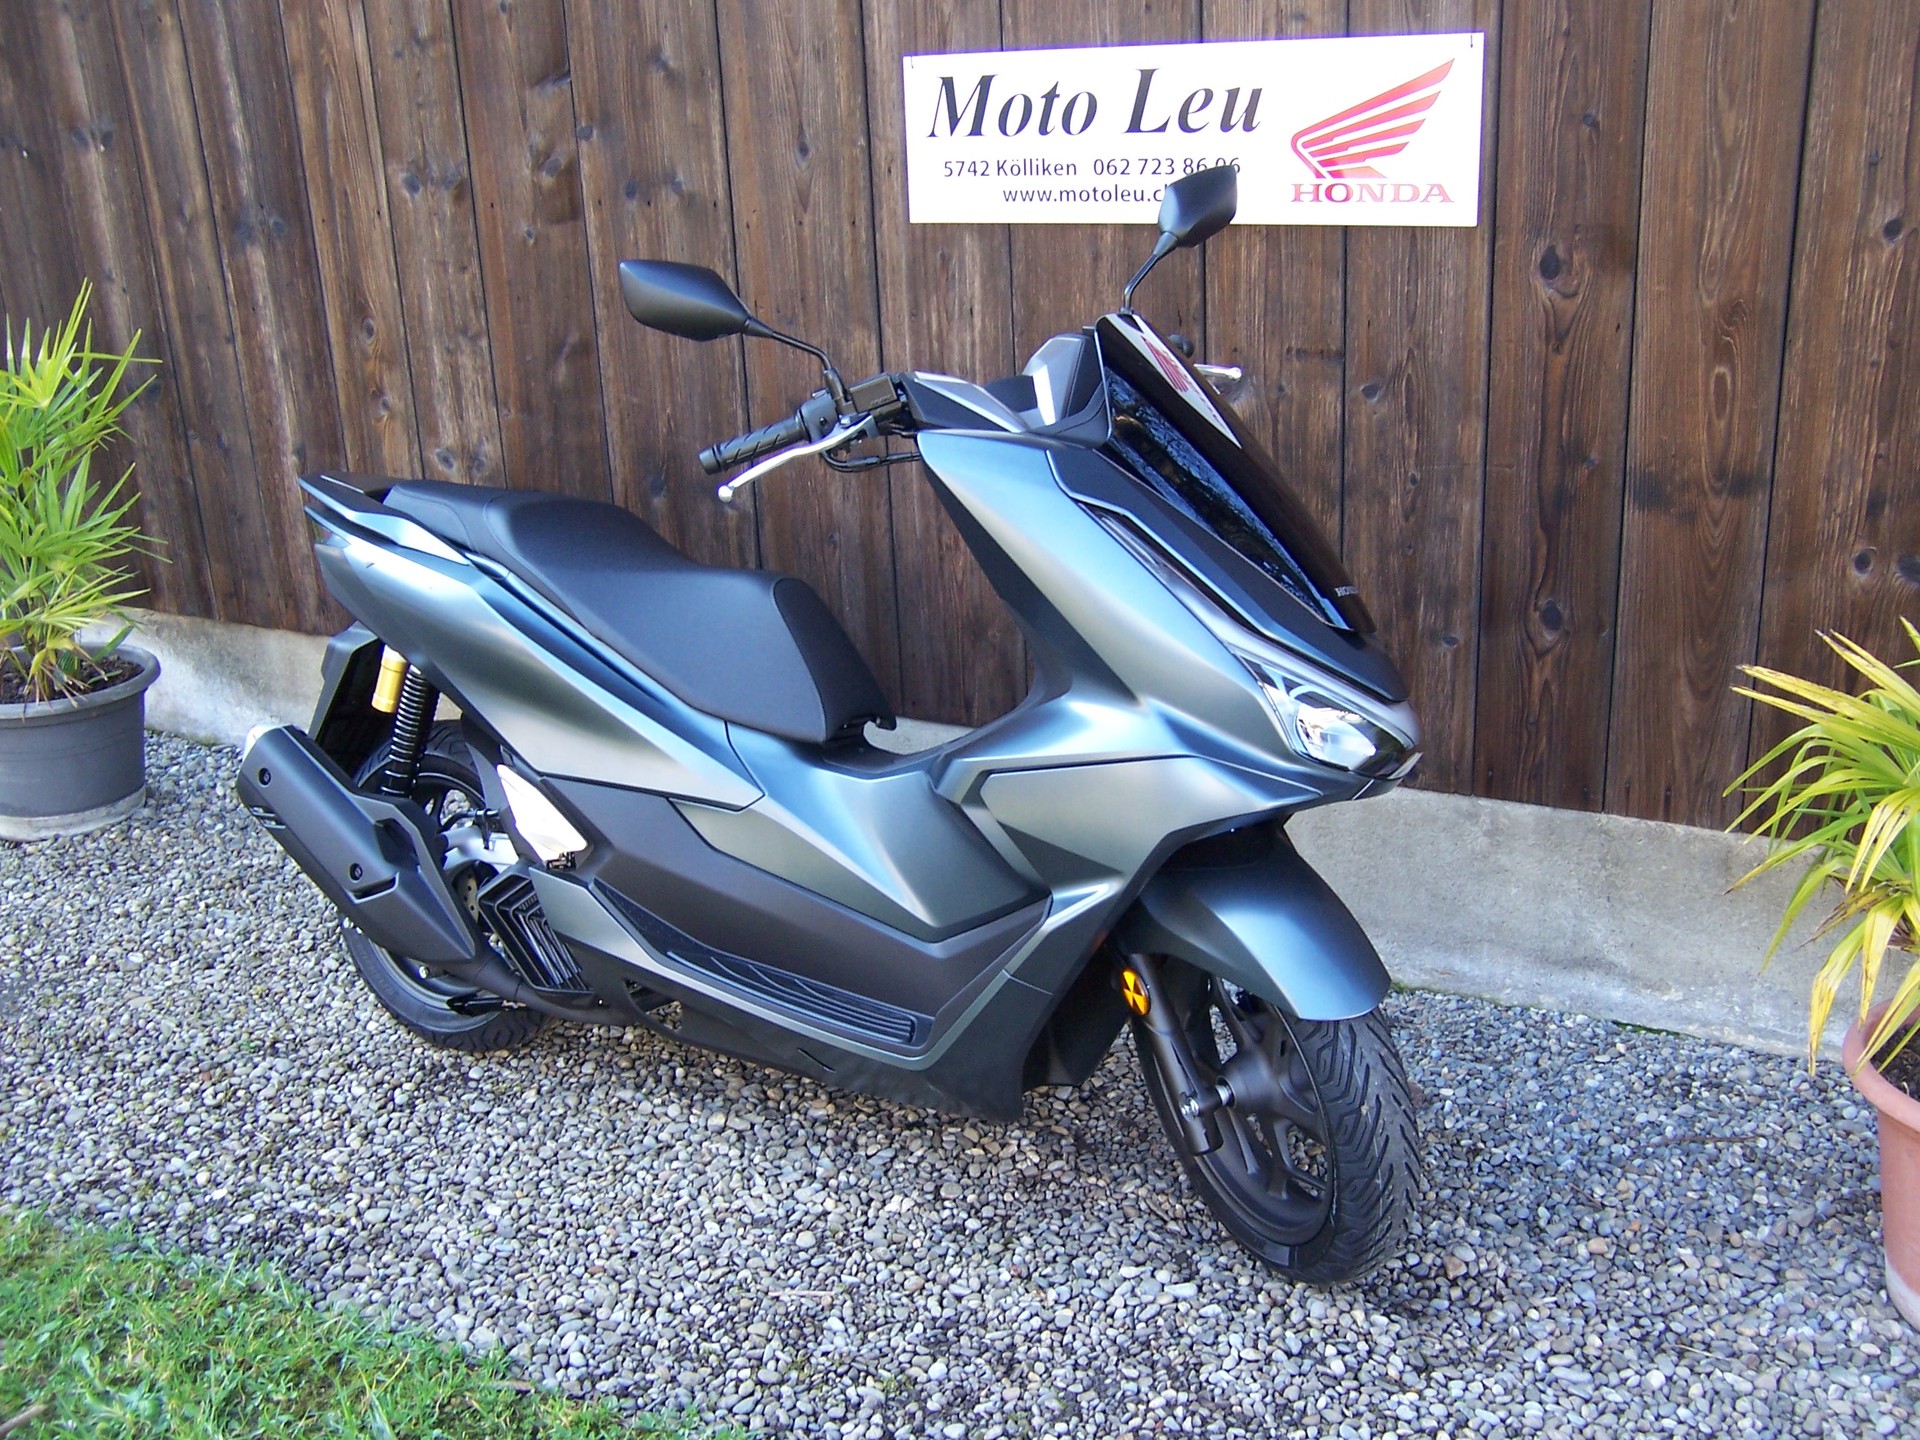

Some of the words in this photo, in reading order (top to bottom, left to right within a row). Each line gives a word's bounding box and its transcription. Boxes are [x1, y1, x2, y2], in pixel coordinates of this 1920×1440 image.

[926, 73, 1098, 138] Moto
[1121, 67, 1263, 134] Leu
[943, 160, 990, 178] 5742
[996, 157, 1077, 177] Kölliken
[1093, 158, 1131, 176] 062
[1137, 157, 1175, 175] 723
[1182, 157, 1208, 176] 86
[1002, 183, 1168, 203] www.motoleu.c
[1290, 182, 1455, 204] HONDA
